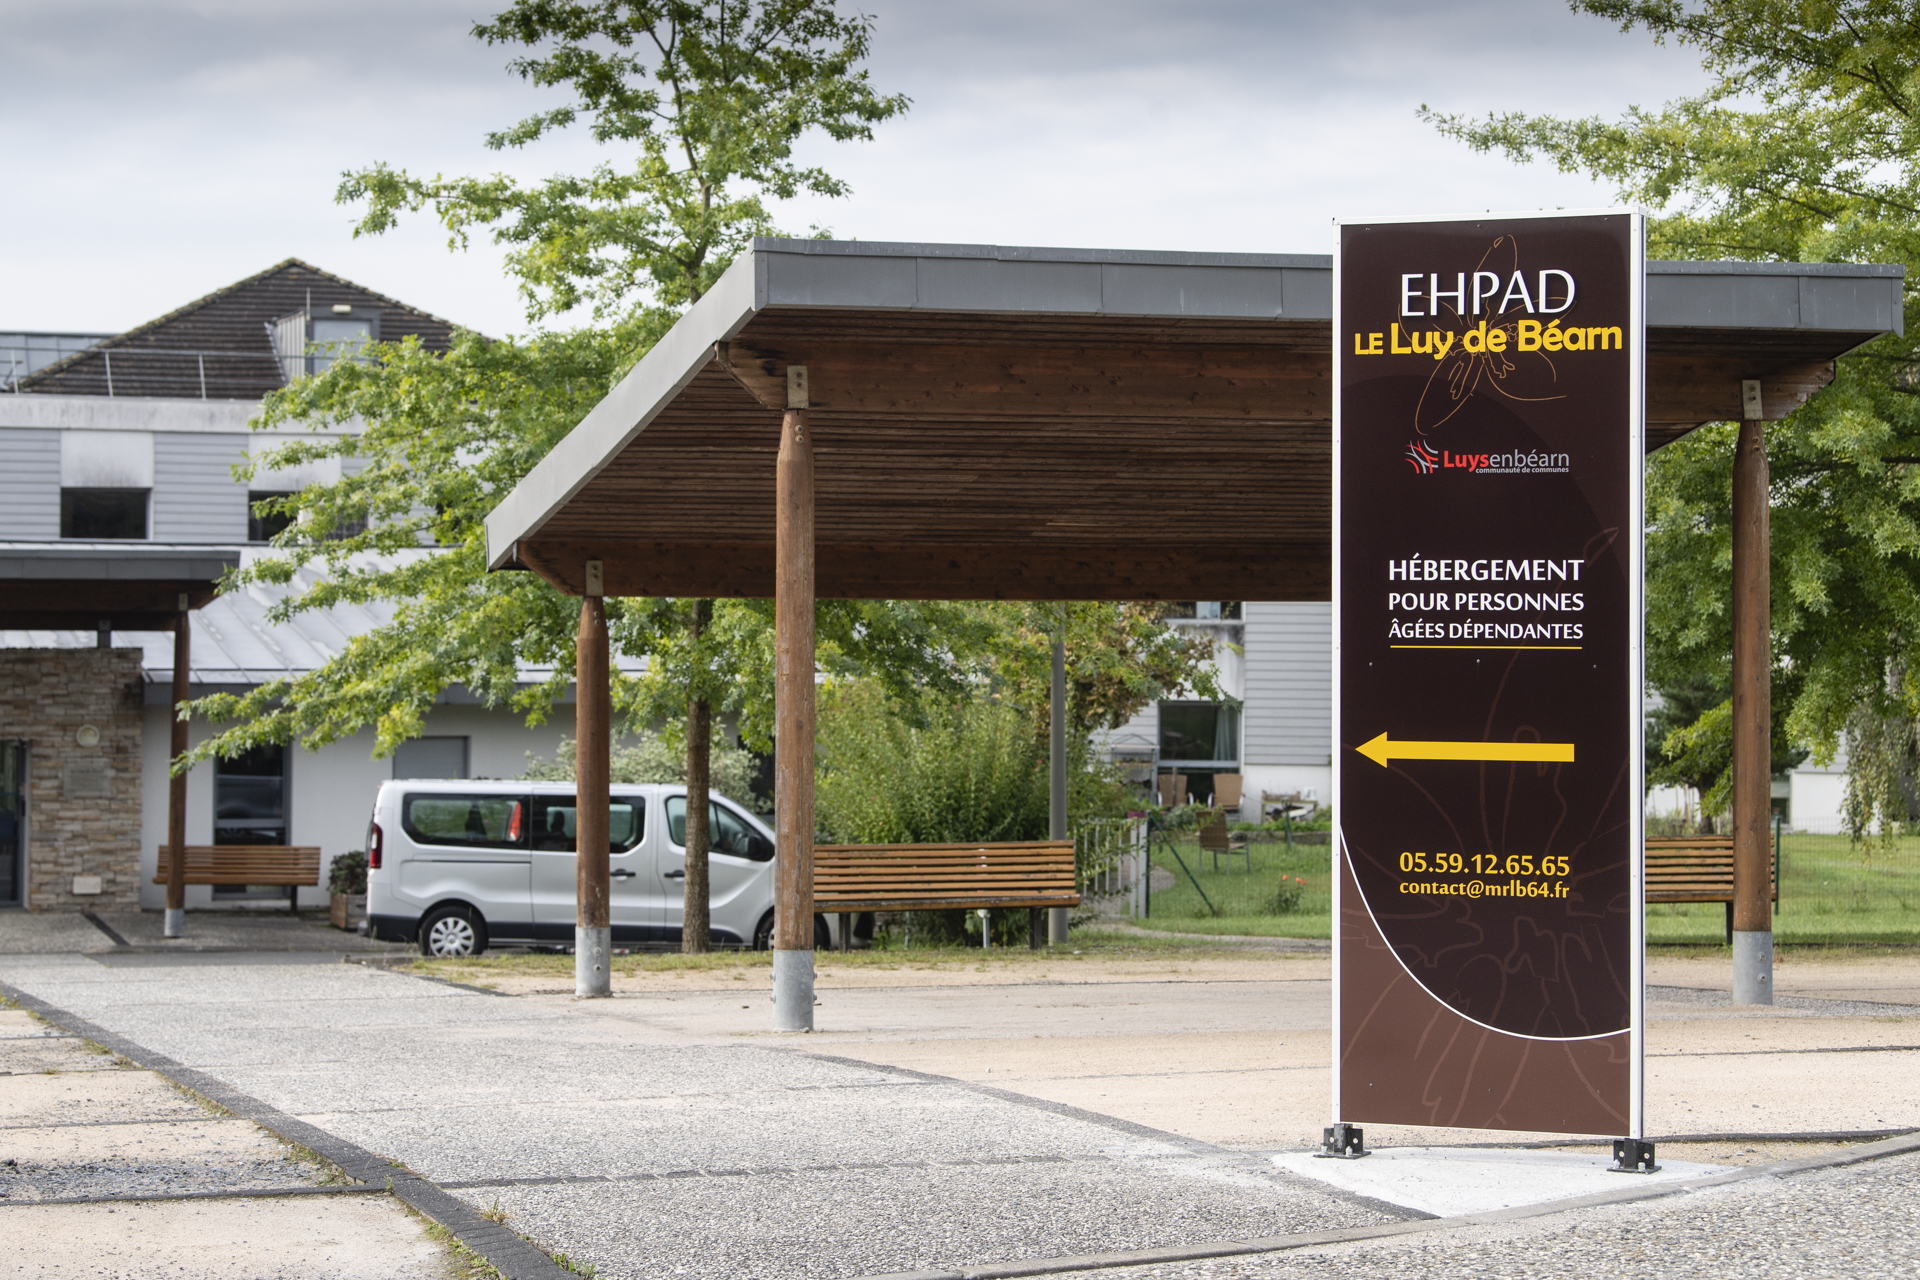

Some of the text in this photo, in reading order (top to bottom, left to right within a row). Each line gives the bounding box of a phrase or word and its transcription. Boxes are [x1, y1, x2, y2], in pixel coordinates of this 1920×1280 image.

[1401, 269, 1576, 316] EHPAD
[1355, 319, 1622, 359] LE Luy de Béarn
[1444, 449, 1569, 472] Luysenbéarn
[1389, 552, 1585, 581] HÉBERGEMENT
[1389, 592, 1585, 611] POUR PERSONNES
[1389, 618, 1584, 639] ÂGÉES DÉPENDANTES
[1399, 852, 1570, 876] 05.59.12.65.65
[1399, 880, 1570, 899] contact@mrlb64.fr
